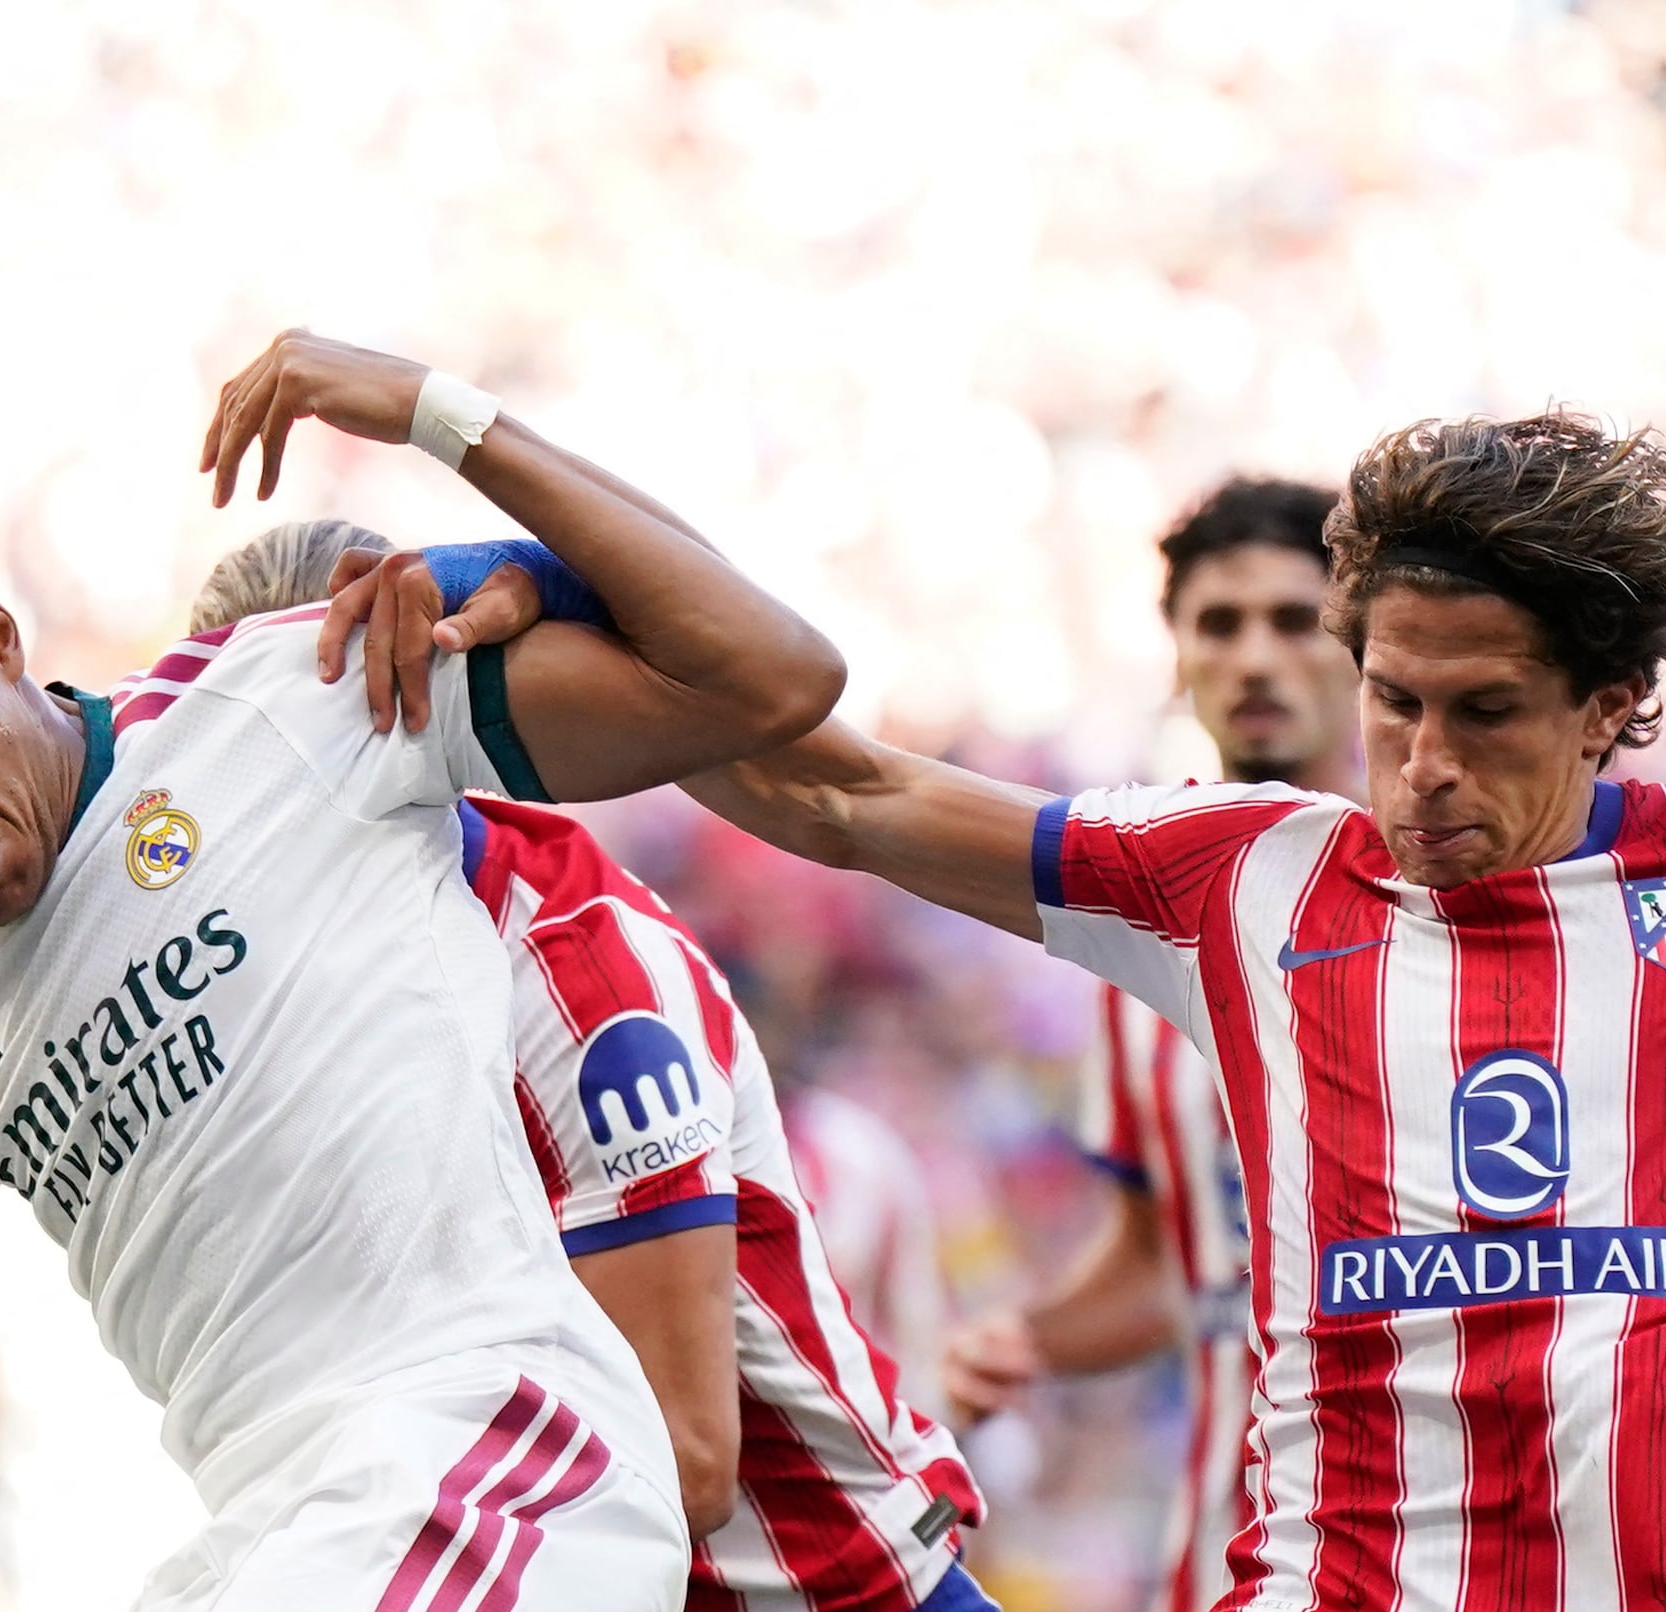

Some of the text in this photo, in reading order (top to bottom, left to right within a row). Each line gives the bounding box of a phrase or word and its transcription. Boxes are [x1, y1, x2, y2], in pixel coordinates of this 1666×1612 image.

[90, 1014, 225, 1175] BETTER
[601, 1117, 722, 1183] kraken
[1333, 1238, 1574, 1304] RIYADH
